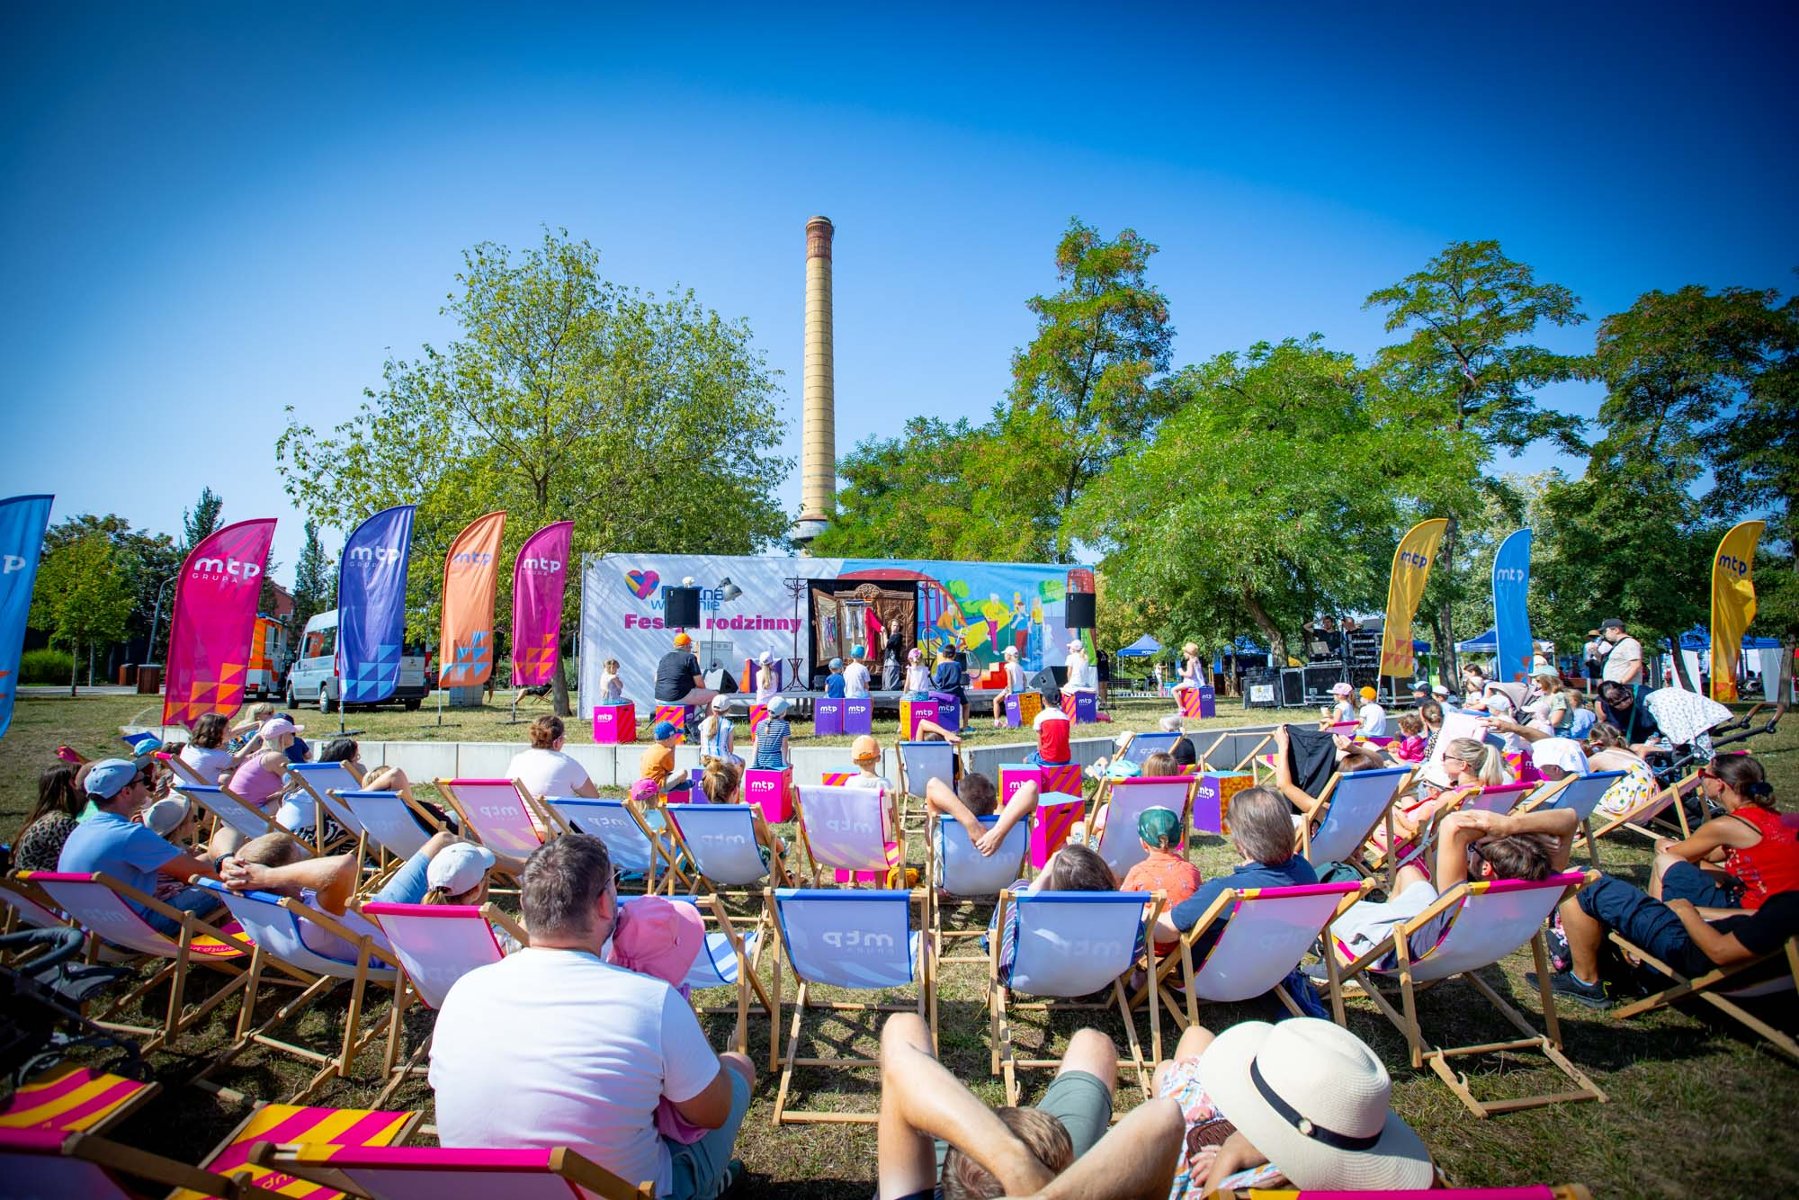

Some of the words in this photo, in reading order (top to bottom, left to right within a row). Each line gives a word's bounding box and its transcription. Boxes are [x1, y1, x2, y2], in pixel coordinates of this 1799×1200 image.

[350, 546, 400, 565] mtp
[453, 552, 491, 566] mtp
[1401, 552, 1427, 568] mtp
[194, 558, 260, 580] mtp
[523, 558, 561, 573] mtp
[1718, 555, 1747, 576] mtp
[192, 573, 238, 583] GRUPA
[1497, 568, 1524, 584] mtp
[706, 614, 802, 634] rodzinny
[916, 709, 933, 717] mtp
[752, 781, 774, 790] mtp
